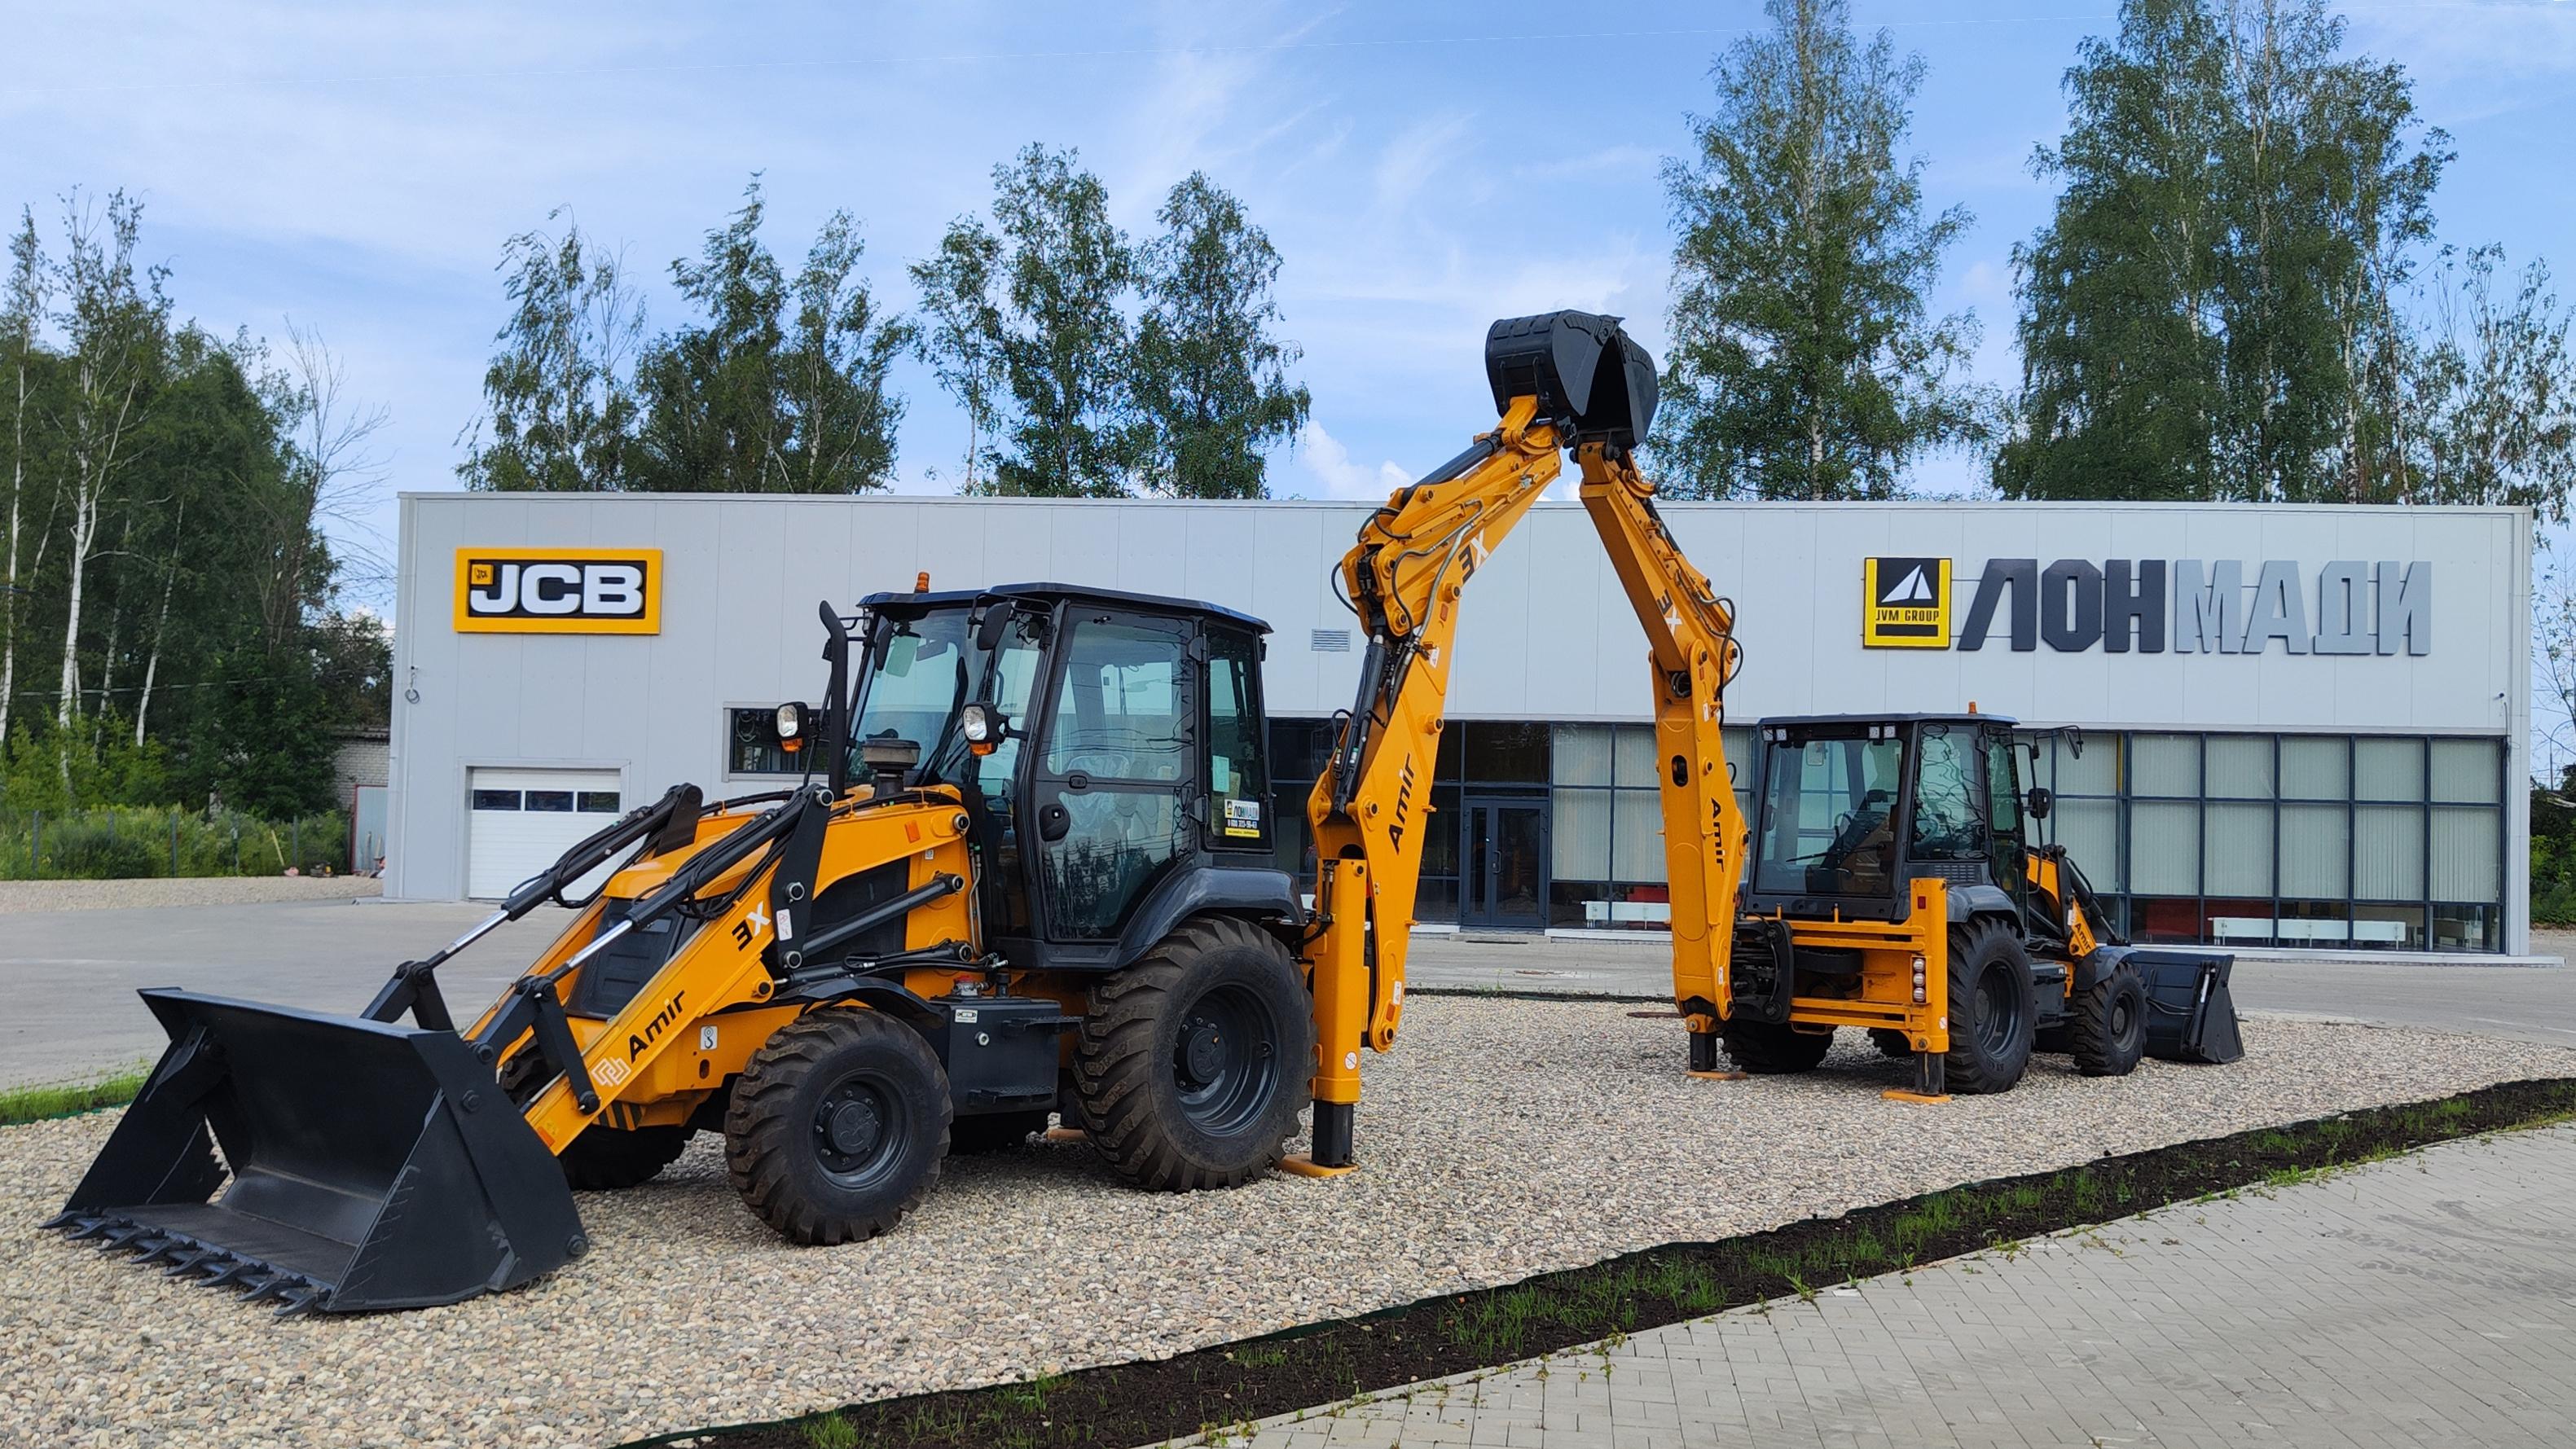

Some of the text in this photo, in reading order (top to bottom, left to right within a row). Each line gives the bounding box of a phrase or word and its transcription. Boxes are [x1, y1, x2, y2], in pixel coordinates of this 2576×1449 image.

[1458, 528, 1489, 584] 3X
[470, 564, 644, 614] JCB
[1875, 609, 1939, 621] JVM GROUP
[1957, 559, 2432, 656] ЛОНМАДИ
[1388, 752, 1414, 855] Amir
[1711, 797, 1725, 872] Amir
[732, 900, 771, 951] 3X
[2075, 923, 2091, 950] Amir
[629, 990, 685, 1065] Amir
